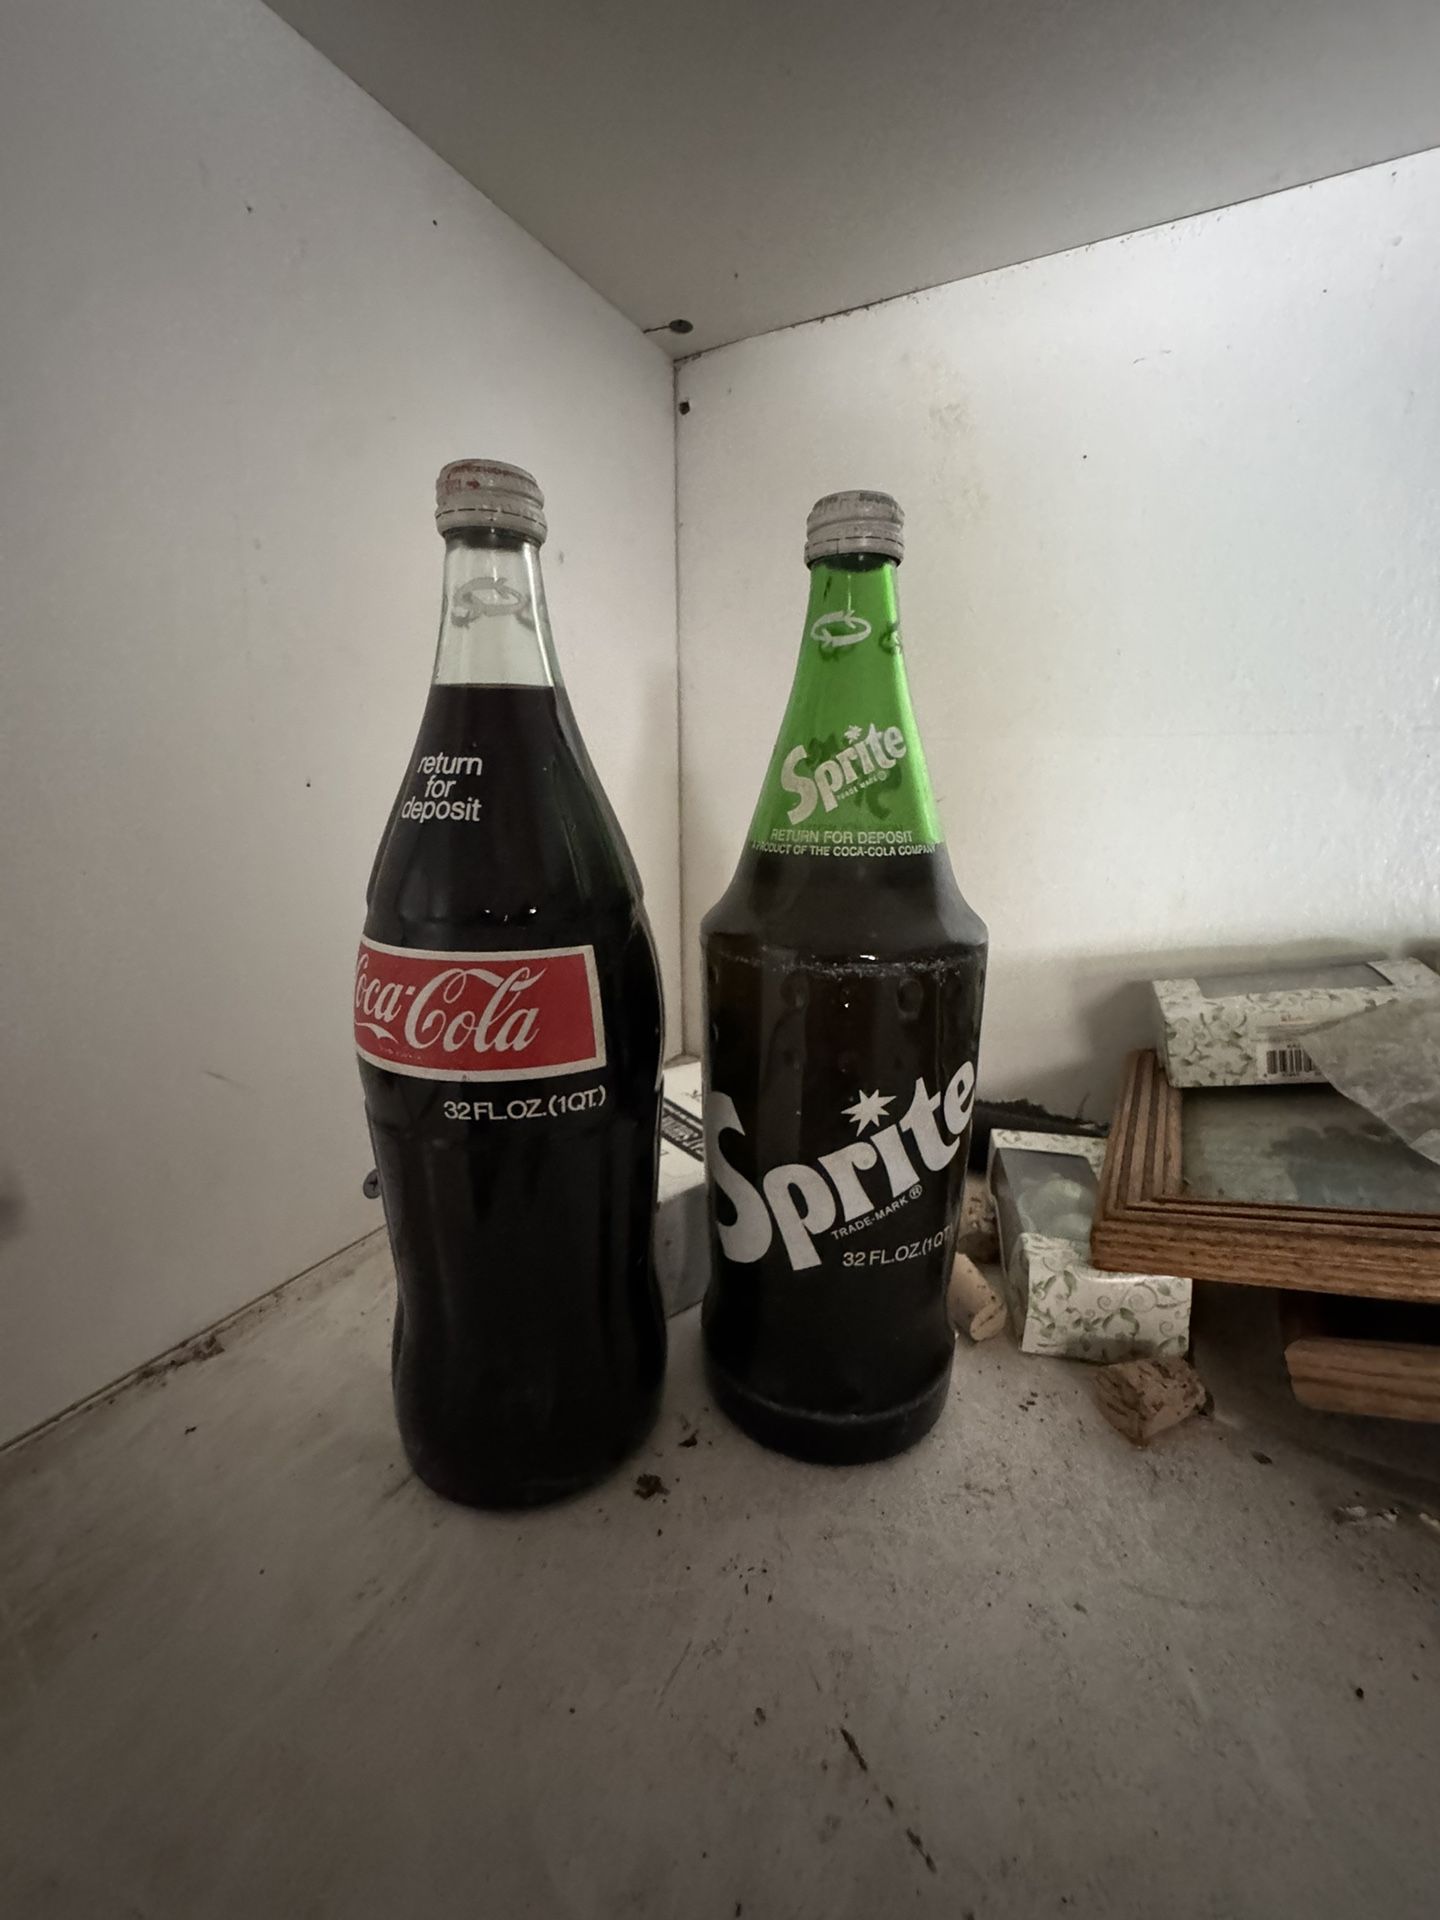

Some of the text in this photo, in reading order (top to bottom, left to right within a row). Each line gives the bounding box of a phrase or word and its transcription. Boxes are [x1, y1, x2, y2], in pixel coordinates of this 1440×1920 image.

[417, 752, 483, 776] return
[780, 723, 906, 825] Sprite
[424, 774, 457, 798] for
[401, 795, 482, 824] deposit
[770, 828, 913, 844] RETURN FOR DEPOSIT
[793, 844, 807, 855] OF
[810, 845, 830, 856] THE
[833, 846, 896, 857] COCA-COLA
[705, 1060, 975, 1271] Sprite
